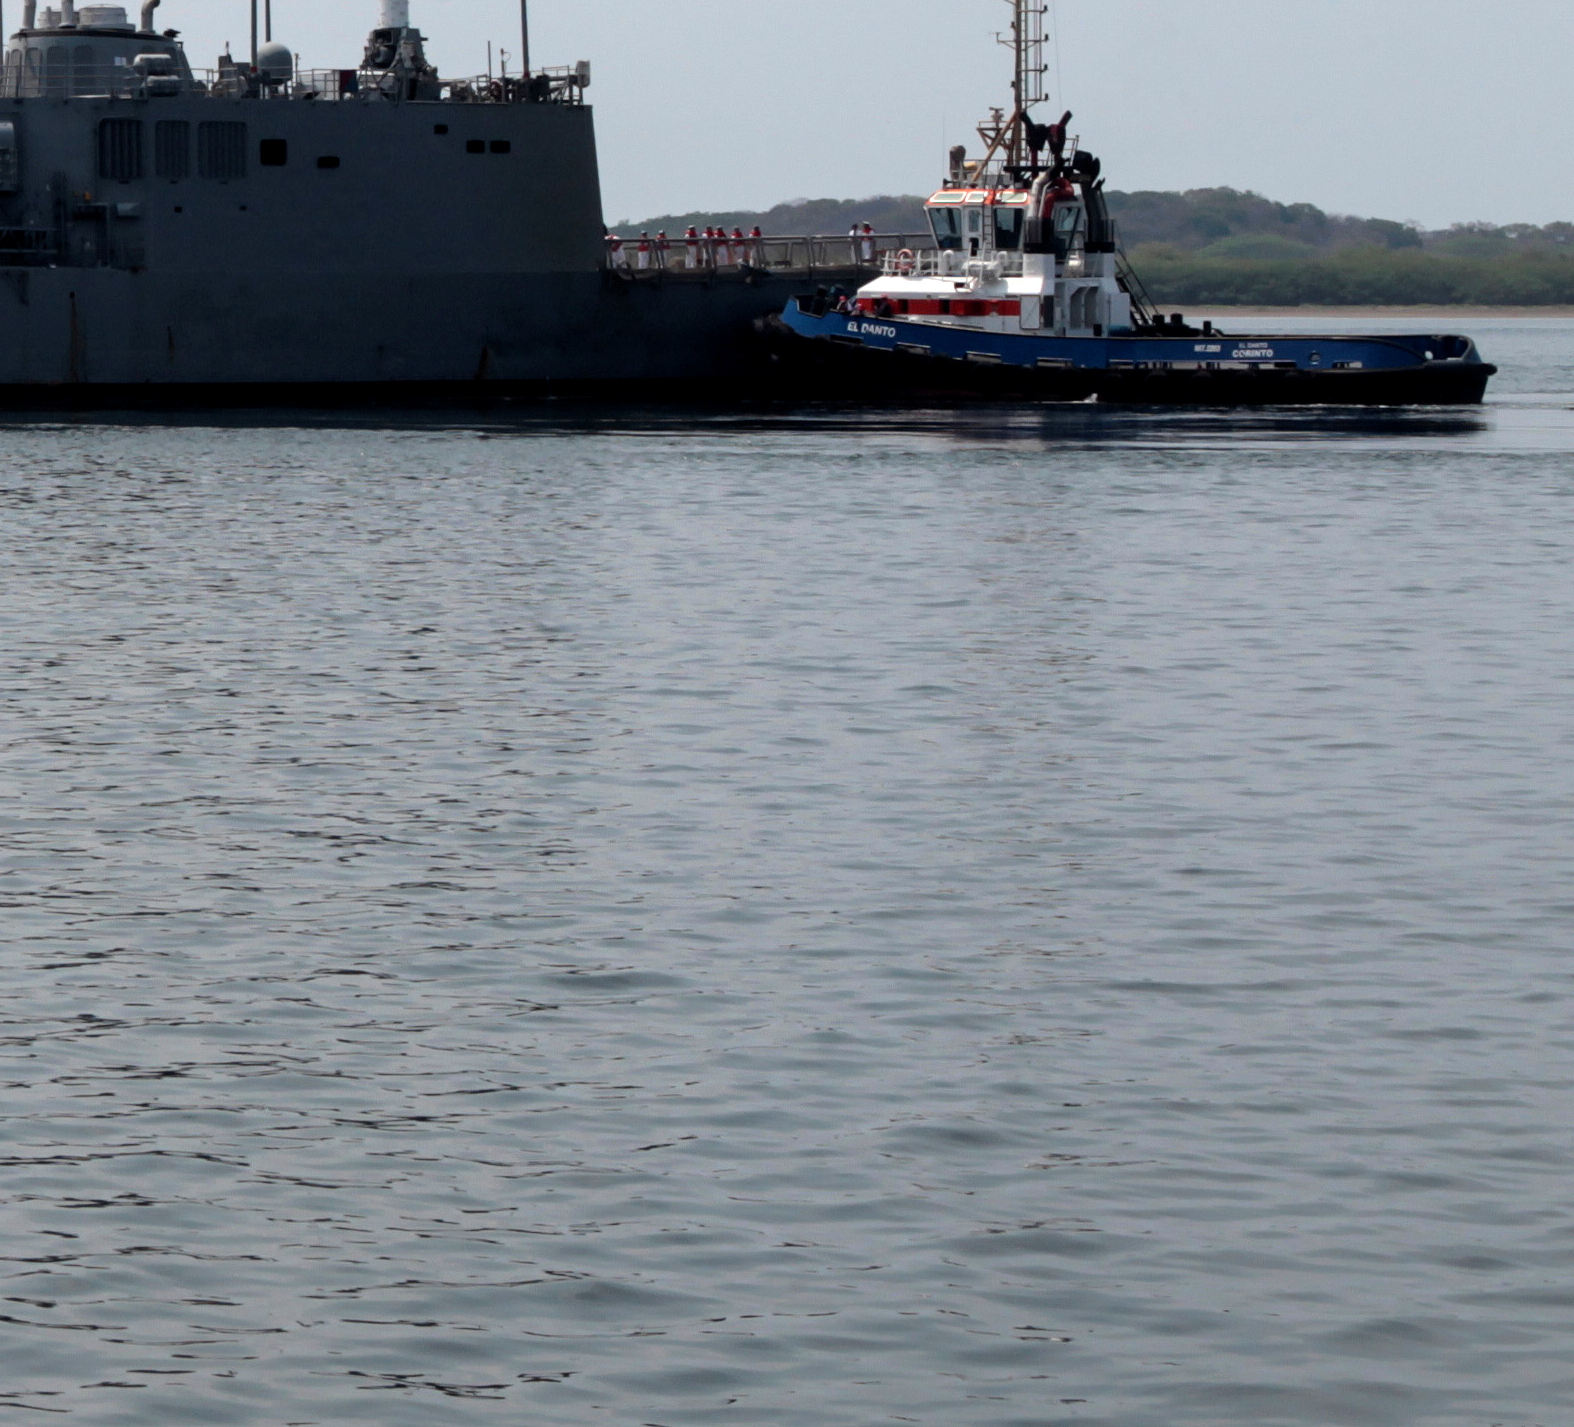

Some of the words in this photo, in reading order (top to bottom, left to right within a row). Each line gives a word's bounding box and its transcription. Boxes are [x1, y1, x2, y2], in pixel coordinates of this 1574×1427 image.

[847, 321, 858, 332] EL
[861, 323, 895, 337] DANTO
[1232, 349, 1273, 358] CORINTO
